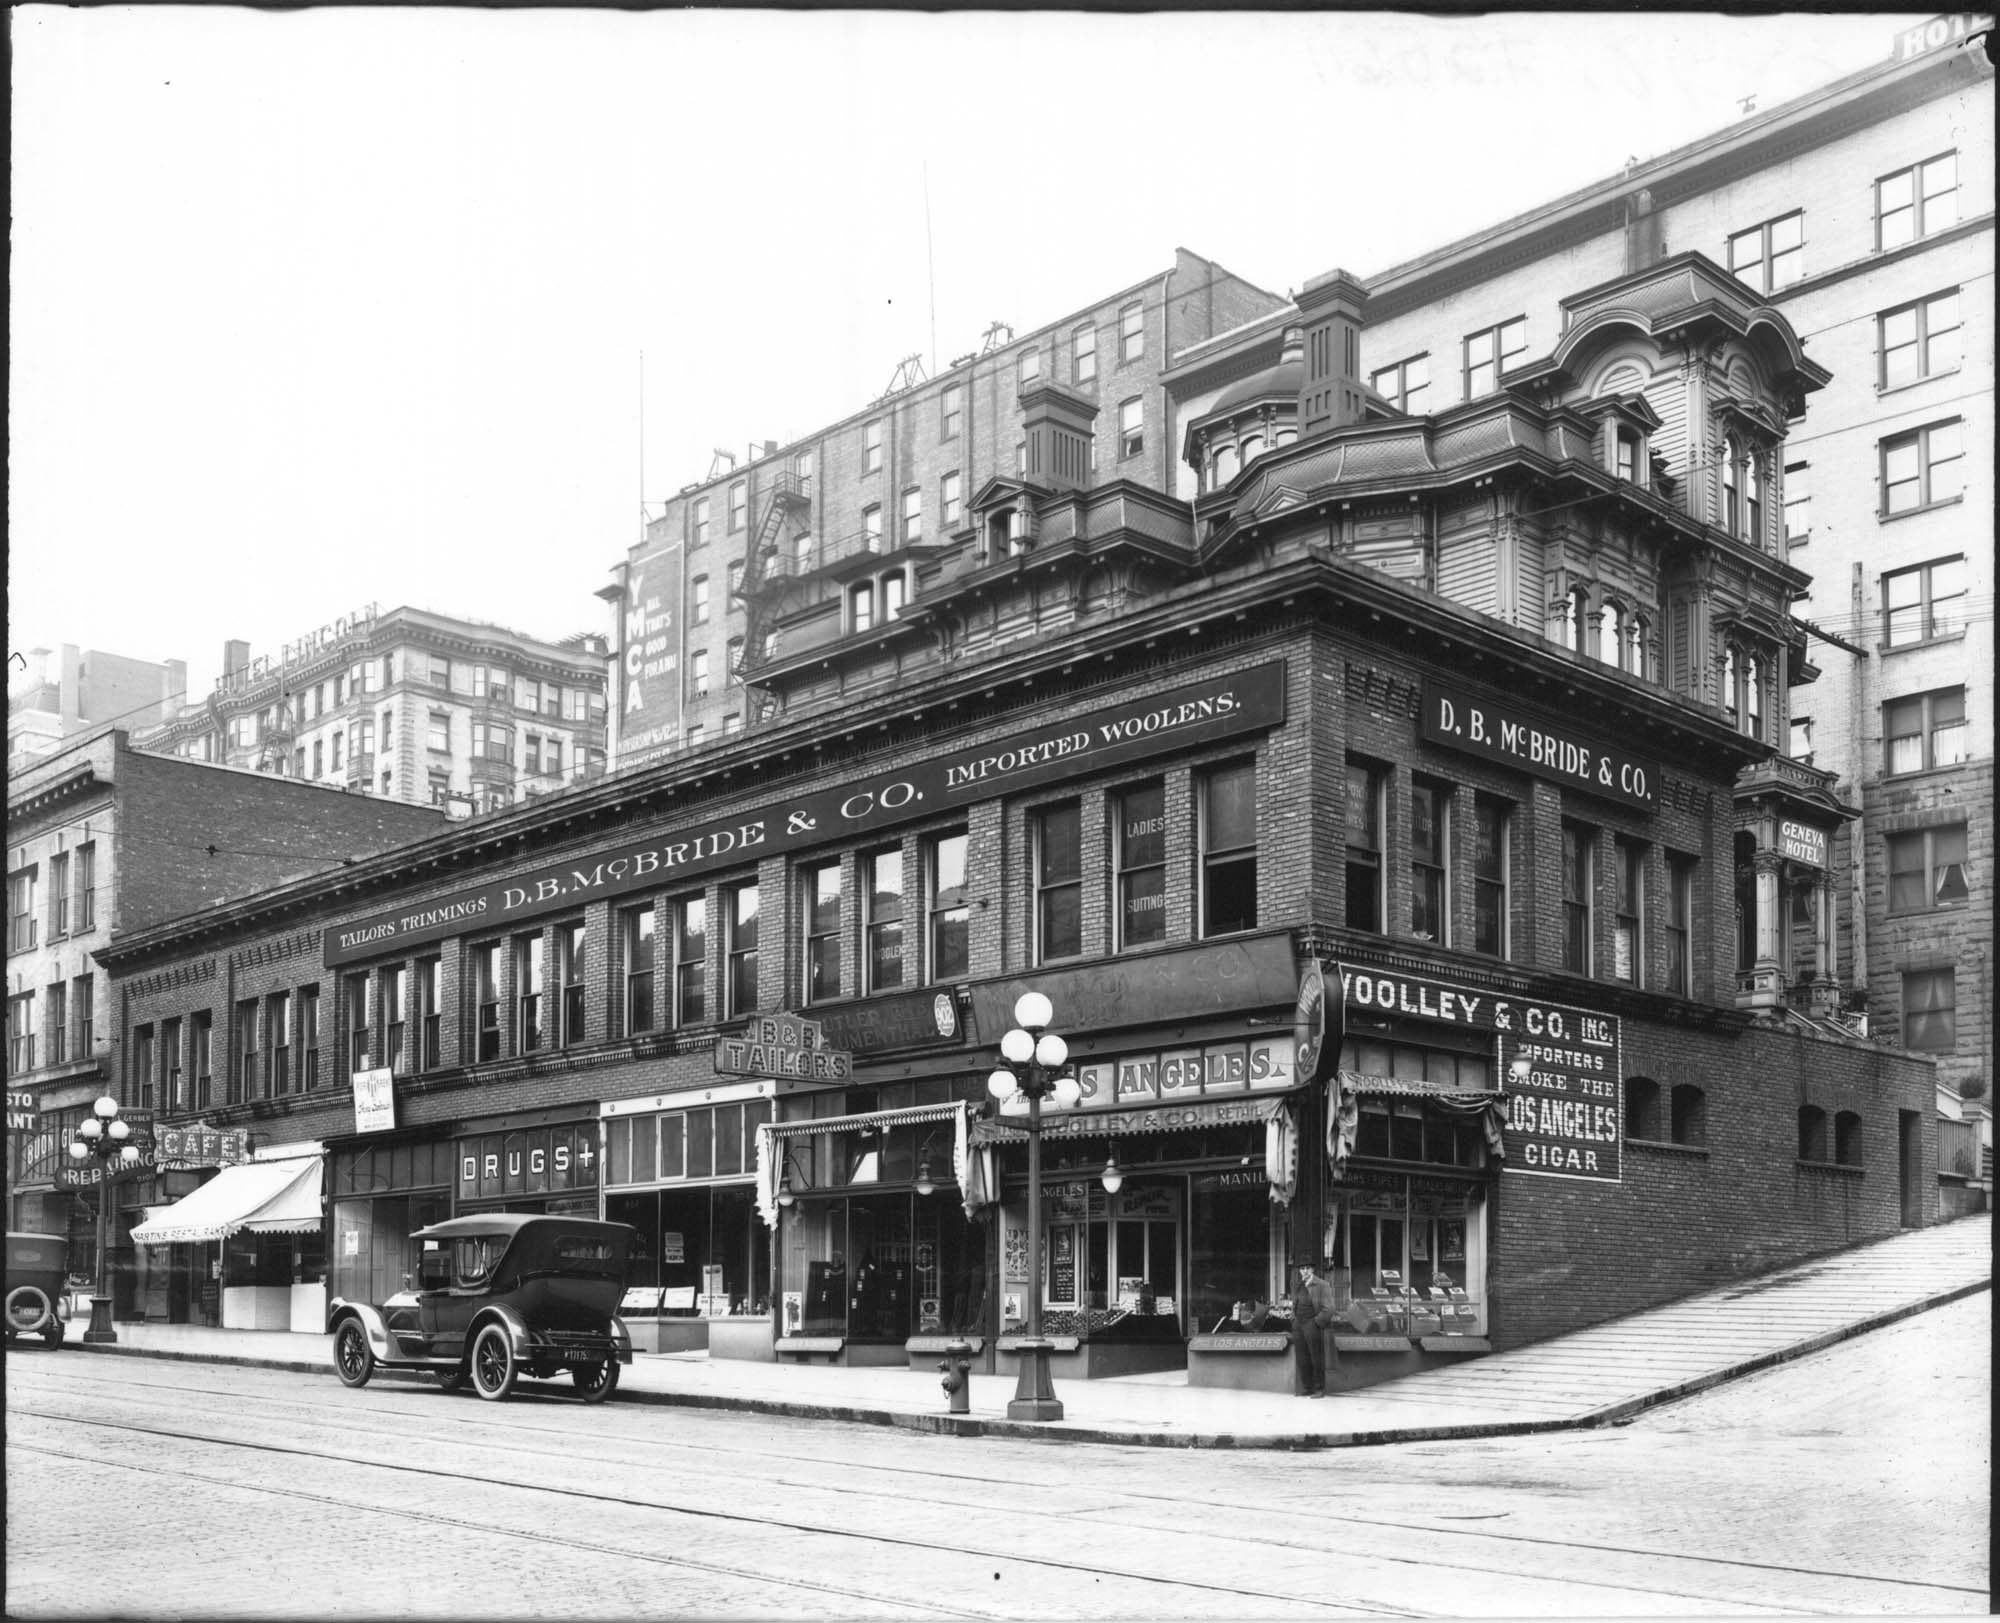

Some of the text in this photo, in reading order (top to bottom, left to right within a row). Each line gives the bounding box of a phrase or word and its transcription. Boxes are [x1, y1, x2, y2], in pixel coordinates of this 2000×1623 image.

[283, 601, 379, 669] LINCOLN
[1598, 757, 1613, 787] &
[1621, 764, 1651, 800] CO.
[339, 921, 395, 949] TAILORS
[401, 897, 487, 932] TRIMMINGS
[786, 810, 816, 835] &
[841, 782, 923, 819] CO.
[946, 731, 1090, 787] IMPORTED
[1100, 692, 1241, 743] WOOLENS.
[1782, 821, 1824, 848] GENEVA
[1786, 838, 1819, 863] HOTEL
[761, 1020, 815, 1050] B & B
[1496, 1003, 1511, 1029] &
[1526, 1008, 1571, 1040] CO.
[1581, 1016, 1614, 1043] INC.
[726, 1041, 848, 1080] TAILORS
[1118, 1048, 1271, 1095] ANGELES
[1580, 1078, 1614, 1098] THE
[1143, 1114, 1158, 1128] &
[1165, 1110, 1201, 1127] CO.
[1539, 1097, 1616, 1142] ANGELES
[27, 1134, 54, 1165] BUON
[164, 1132, 237, 1159] CAFE
[1524, 1143, 1599, 1171] CIGAR
[463, 1146, 569, 1181] DRUGS
[1219, 1172, 1267, 1186] MANIL
